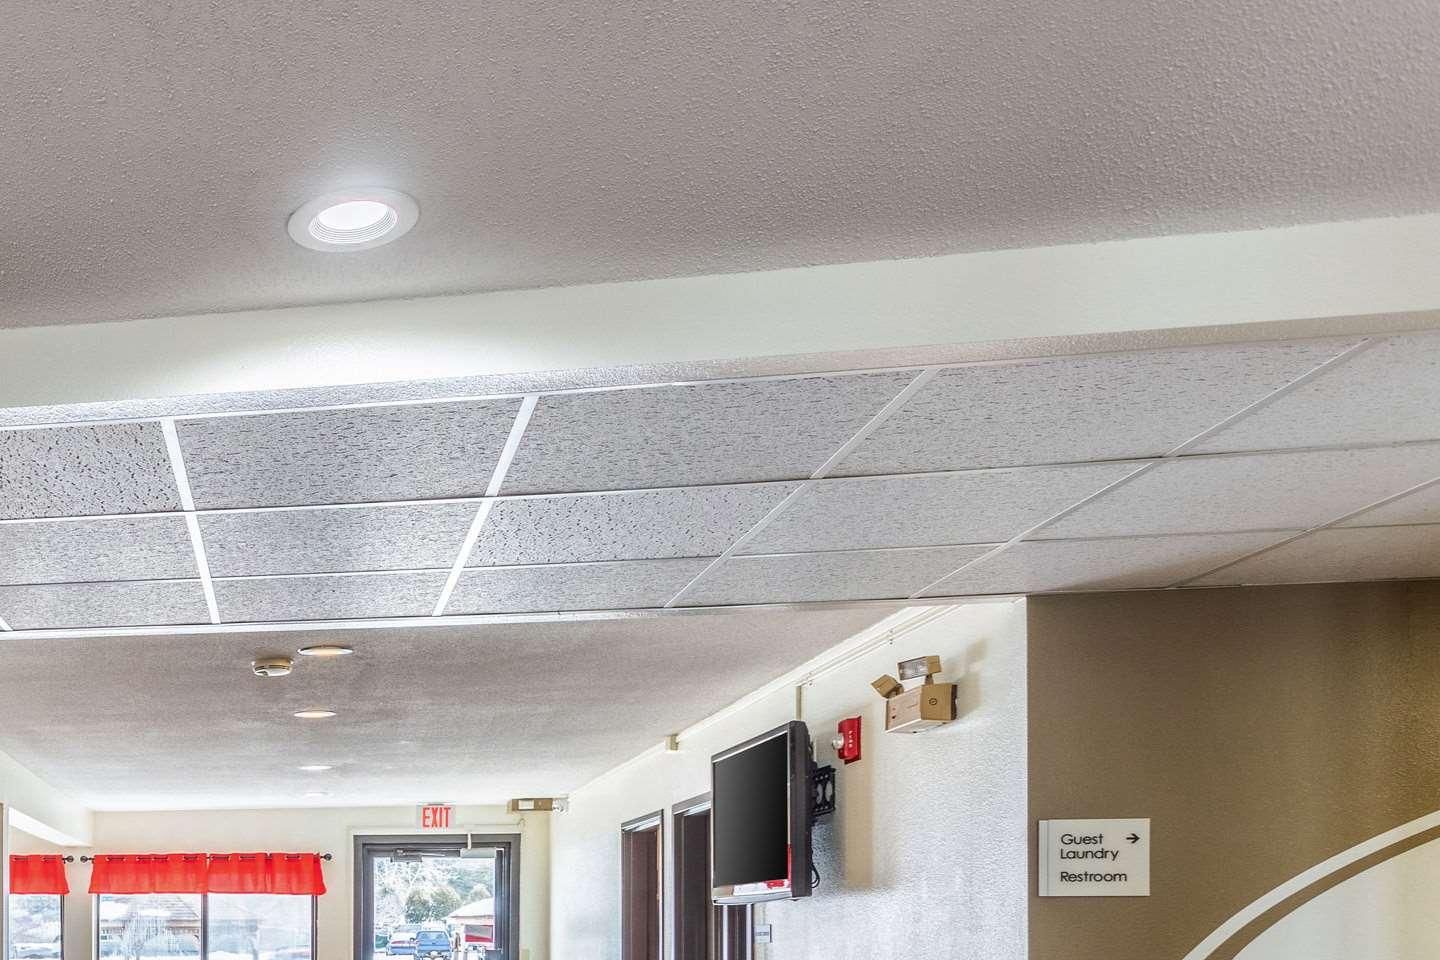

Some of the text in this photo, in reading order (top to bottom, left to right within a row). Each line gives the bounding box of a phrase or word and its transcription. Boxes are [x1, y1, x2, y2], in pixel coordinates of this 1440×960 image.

[422, 806, 451, 828] EXIT
[1060, 833, 1104, 846] Guest
[1060, 848, 1120, 862] Laundry
[1060, 871, 1128, 883] Restroom
